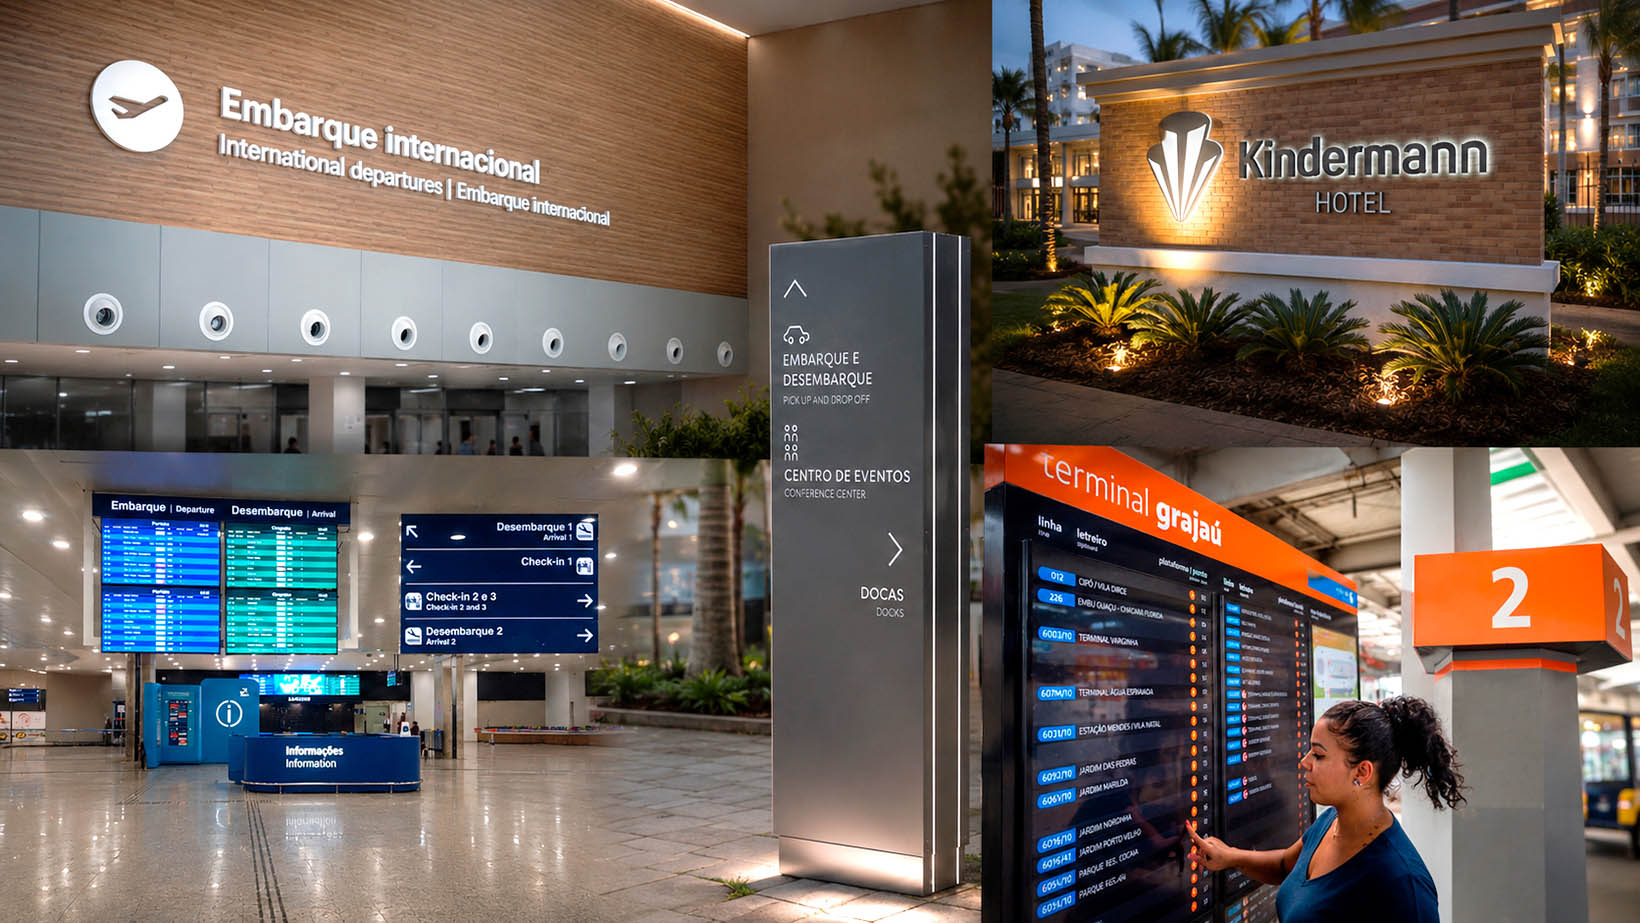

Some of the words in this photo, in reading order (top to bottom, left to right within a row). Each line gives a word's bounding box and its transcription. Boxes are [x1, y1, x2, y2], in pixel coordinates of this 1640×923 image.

[219, 85, 378, 150] Embarque
[384, 126, 541, 185] internacional
[1239, 136, 1489, 180] Kindermann
[216, 133, 346, 177] International
[350, 158, 445, 197] departures
[456, 182, 531, 213] Embarque
[532, 196, 611, 227] internacional
[1315, 191, 1393, 215] HOTEL
[783, 352, 849, 368] EMBARQUE
[852, 351, 860, 365] E
[783, 371, 873, 388] DESEMBARQUE
[783, 395, 800, 405] PICK
[801, 395, 811, 405] UP
[812, 395, 830, 405] AND
[831, 394, 853, 405] DROP
[853, 394, 871, 404] OFF
[784, 468, 832, 482] CENTRO
[835, 469, 851, 482] DE
[854, 469, 912, 483] EVENTOS
[784, 487, 835, 498] CONFERENCE
[836, 488, 866, 499] CENTER
[1039, 451, 1149, 517] terminal
[1156, 501, 1222, 547] grajaú
[111, 501, 166, 514] Embarque
[176, 505, 215, 515] Departure
[231, 505, 304, 519] Desembarque
[311, 510, 336, 518] Arrival
[496, 522, 565, 533] Desembarque
[567, 522, 573, 532] 1
[1037, 515, 1062, 533] linha
[543, 533, 567, 541] Arrival
[568, 533, 573, 541] 1
[1076, 528, 1108, 547] letreiro
[521, 557, 565, 566] Check-in
[567, 557, 573, 566] 1
[1050, 571, 1064, 582] 012
[426, 592, 471, 601] Check-in
[472, 592, 479, 601] 2
[490, 592, 497, 601] 3
[860, 586, 904, 602] DOCAS
[1049, 592, 1063, 603] 226
[1491, 566, 1532, 629] 2
[876, 607, 905, 618] DOCKS
[1612, 576, 1626, 641] 2
[426, 626, 494, 637] Desembarque
[496, 626, 503, 636] 2
[426, 638, 450, 646] Arrival
[450, 638, 456, 646] 2
[1078, 633, 1110, 645] TERMINAL
[1078, 688, 1109, 697] TERMINAL
[1078, 724, 1106, 736] ESTAÇÃO
[285, 745, 344, 760] Informações
[285, 758, 337, 769] Information
[1079, 763, 1102, 777] JARDIM
[1102, 761, 1116, 771] DAS
[1079, 785, 1102, 798] JARDIM
[1079, 825, 1102, 838] JARDIM
[1079, 845, 1102, 858] JARDIM
[1078, 862, 1105, 879] PARQUE
[1078, 882, 1105, 899] PARQUE
